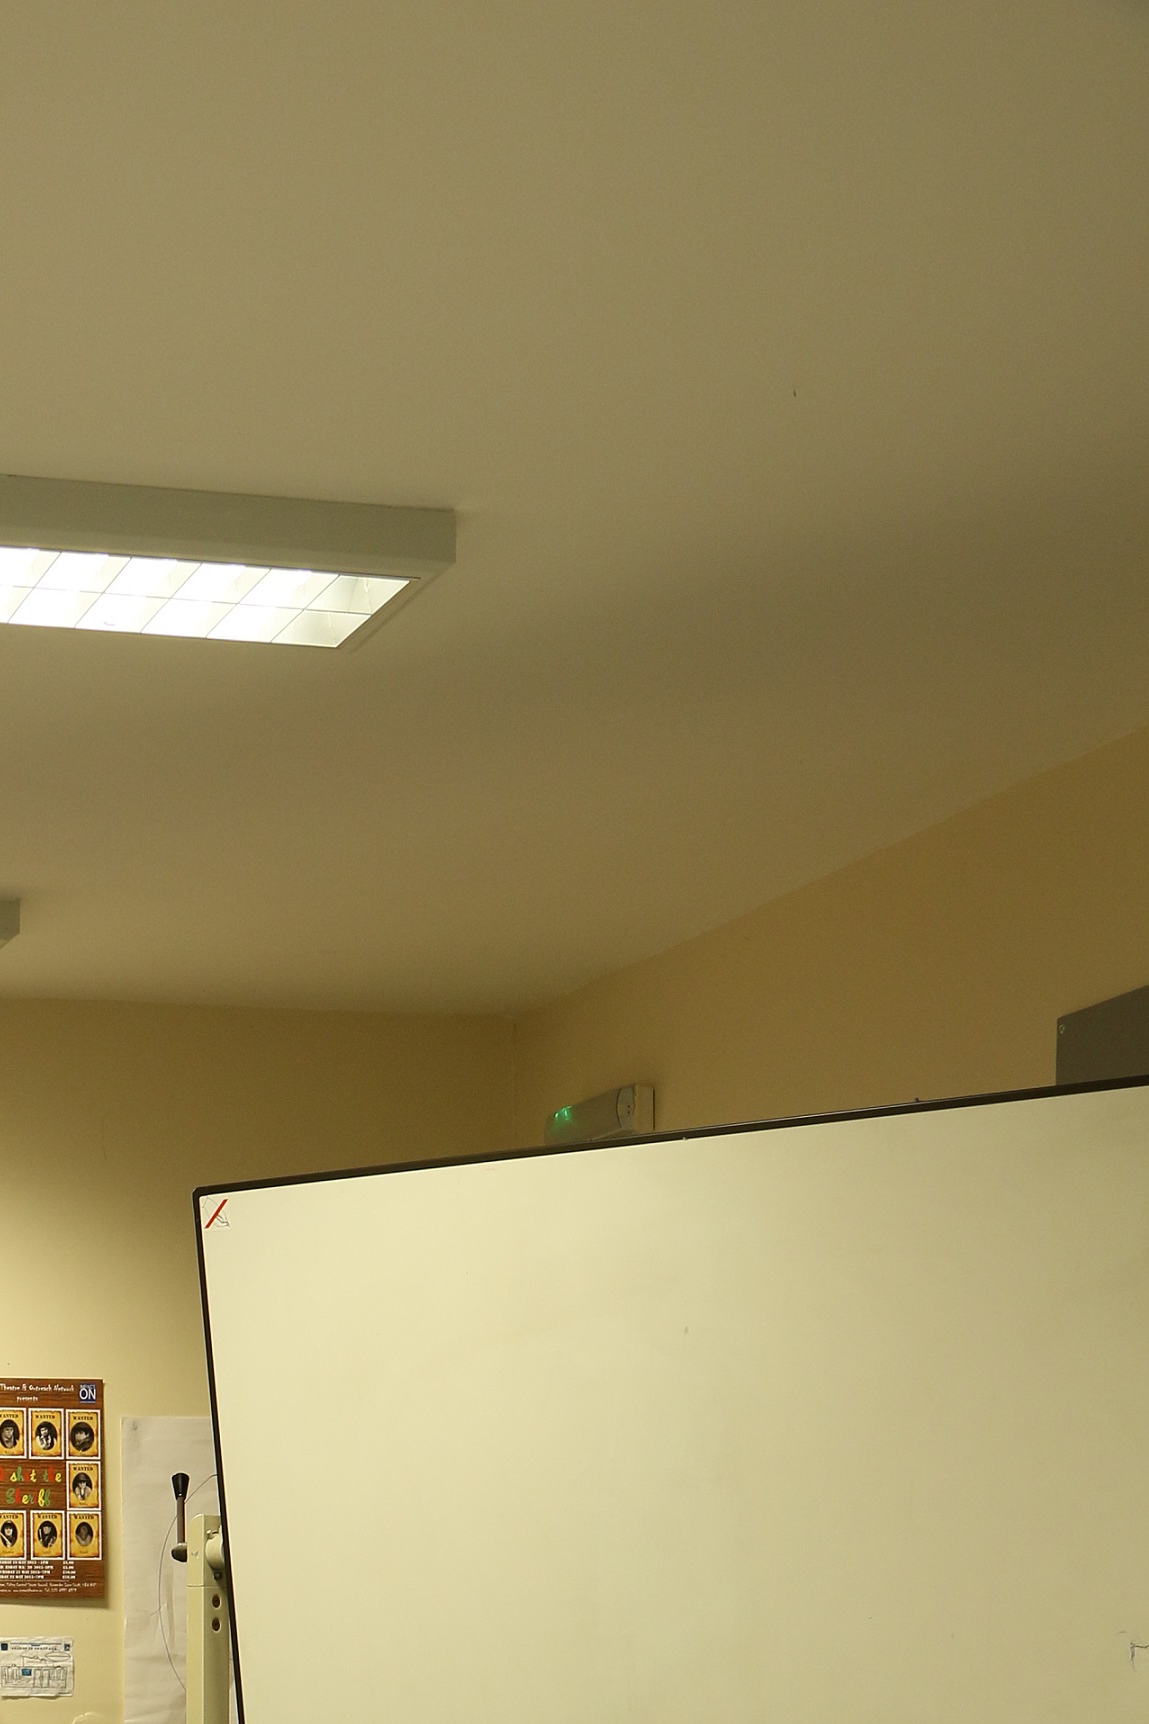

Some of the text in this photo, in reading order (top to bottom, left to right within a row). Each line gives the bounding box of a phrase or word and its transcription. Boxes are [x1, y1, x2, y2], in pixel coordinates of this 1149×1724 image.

[0, 1383, 20, 1392] Theatre
[28, 1384, 52, 1392] Outreach
[53, 1383, 75, 1392] Network
[79, 1389, 96, 1400] ON
